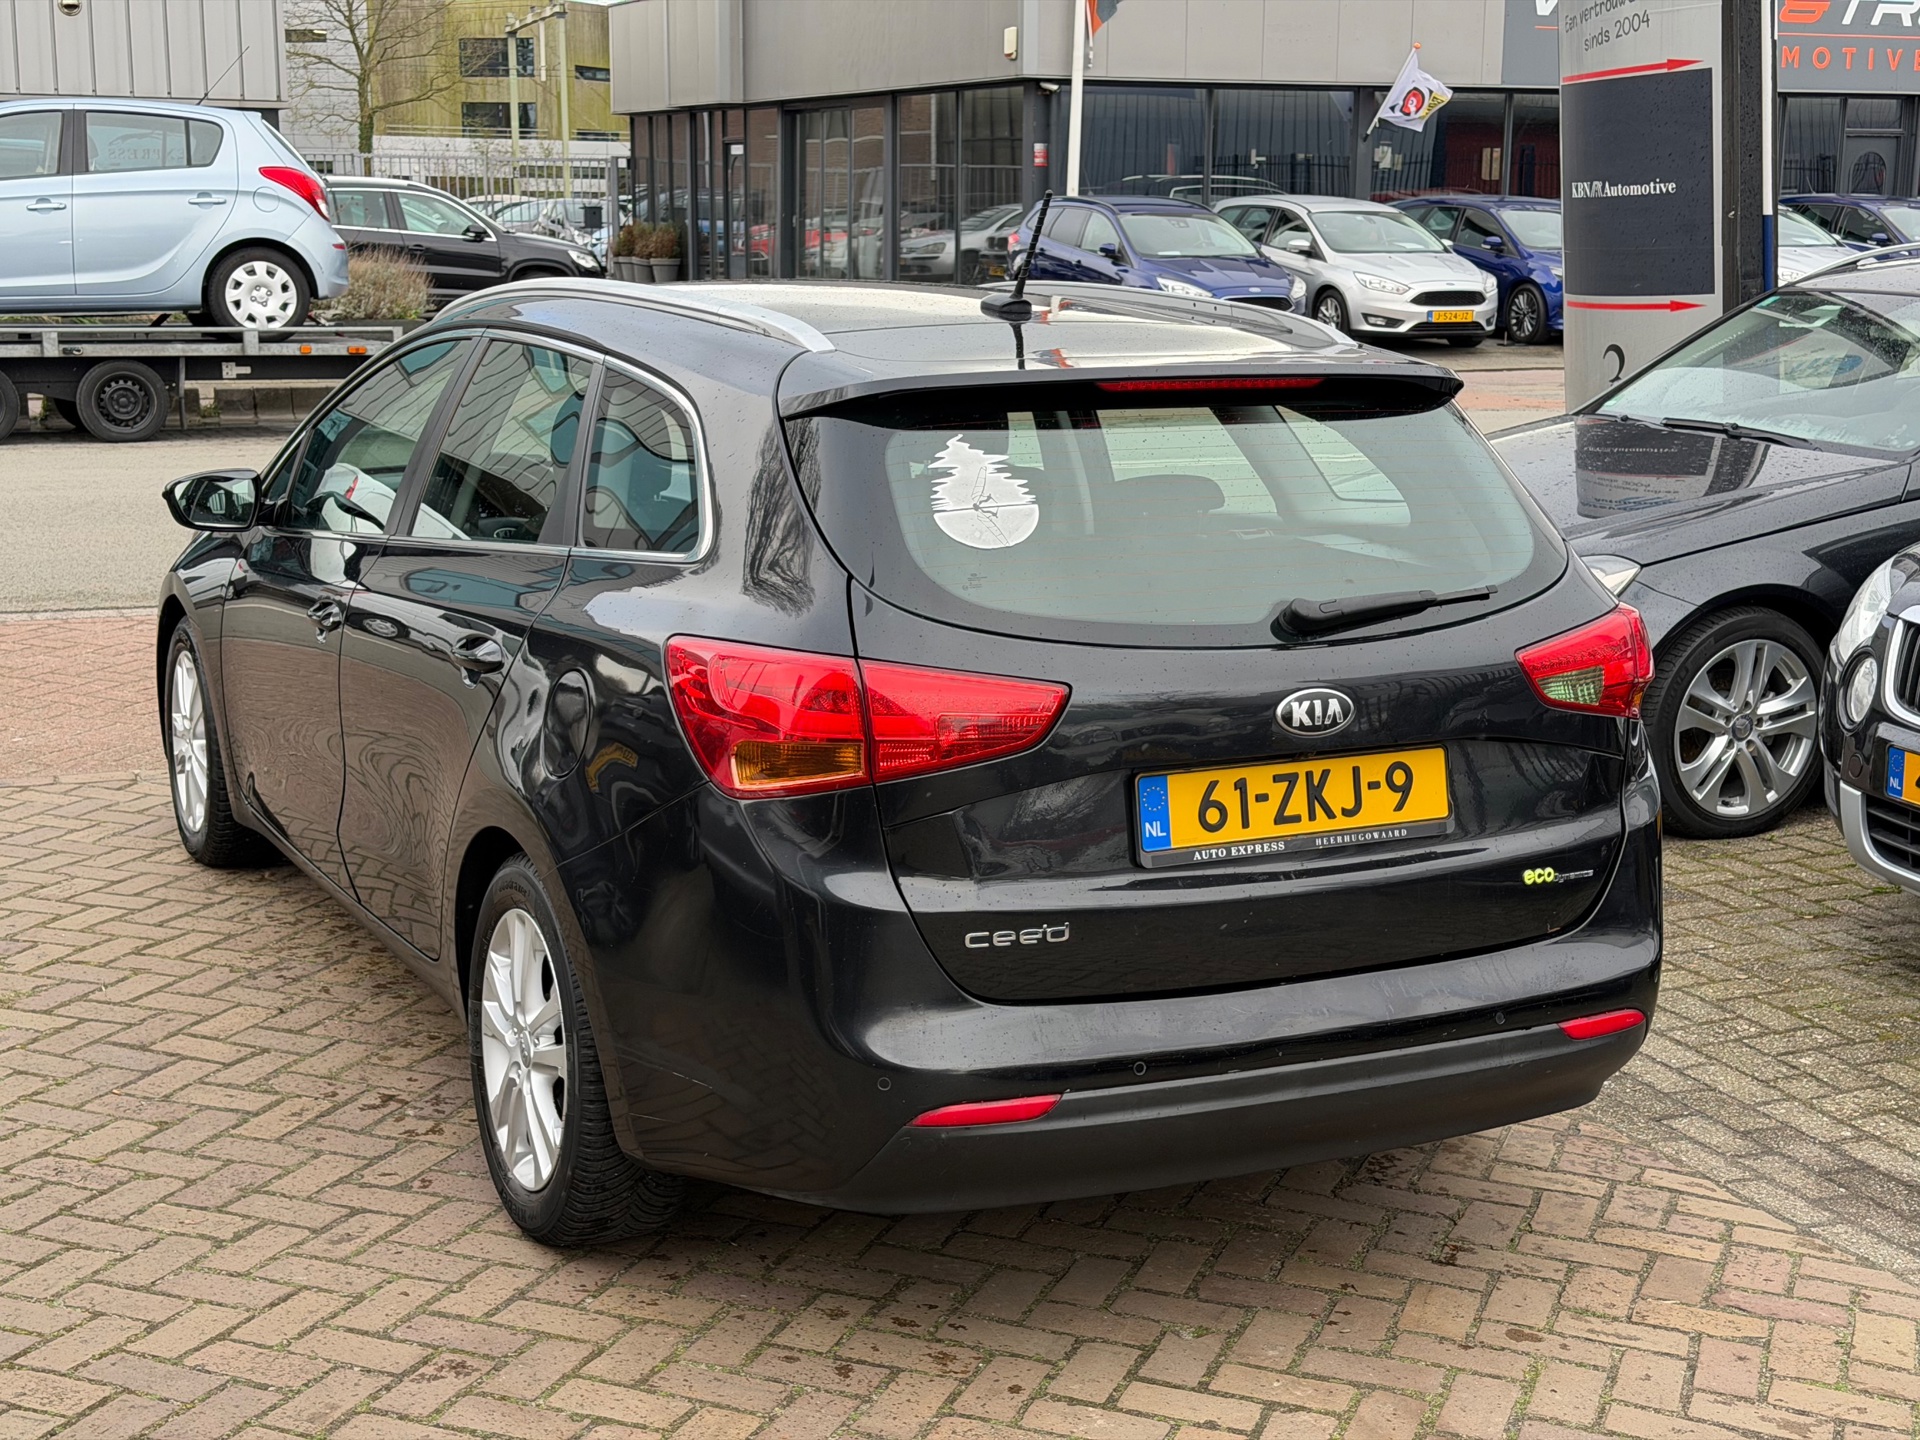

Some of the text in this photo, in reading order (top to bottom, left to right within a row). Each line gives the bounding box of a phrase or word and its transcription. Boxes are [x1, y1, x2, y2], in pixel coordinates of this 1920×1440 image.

[1584, 9, 1650, 51] sinds 2004
[1603, 178, 1676, 197] Automotive
[1290, 698, 1344, 727] KIA
[1144, 760, 1414, 838] NL 61-ZKJ-9
[1889, 776, 1902, 791] NL
[1193, 828, 1408, 861] AUTO EXPRESS HEERHUGOWAARD
